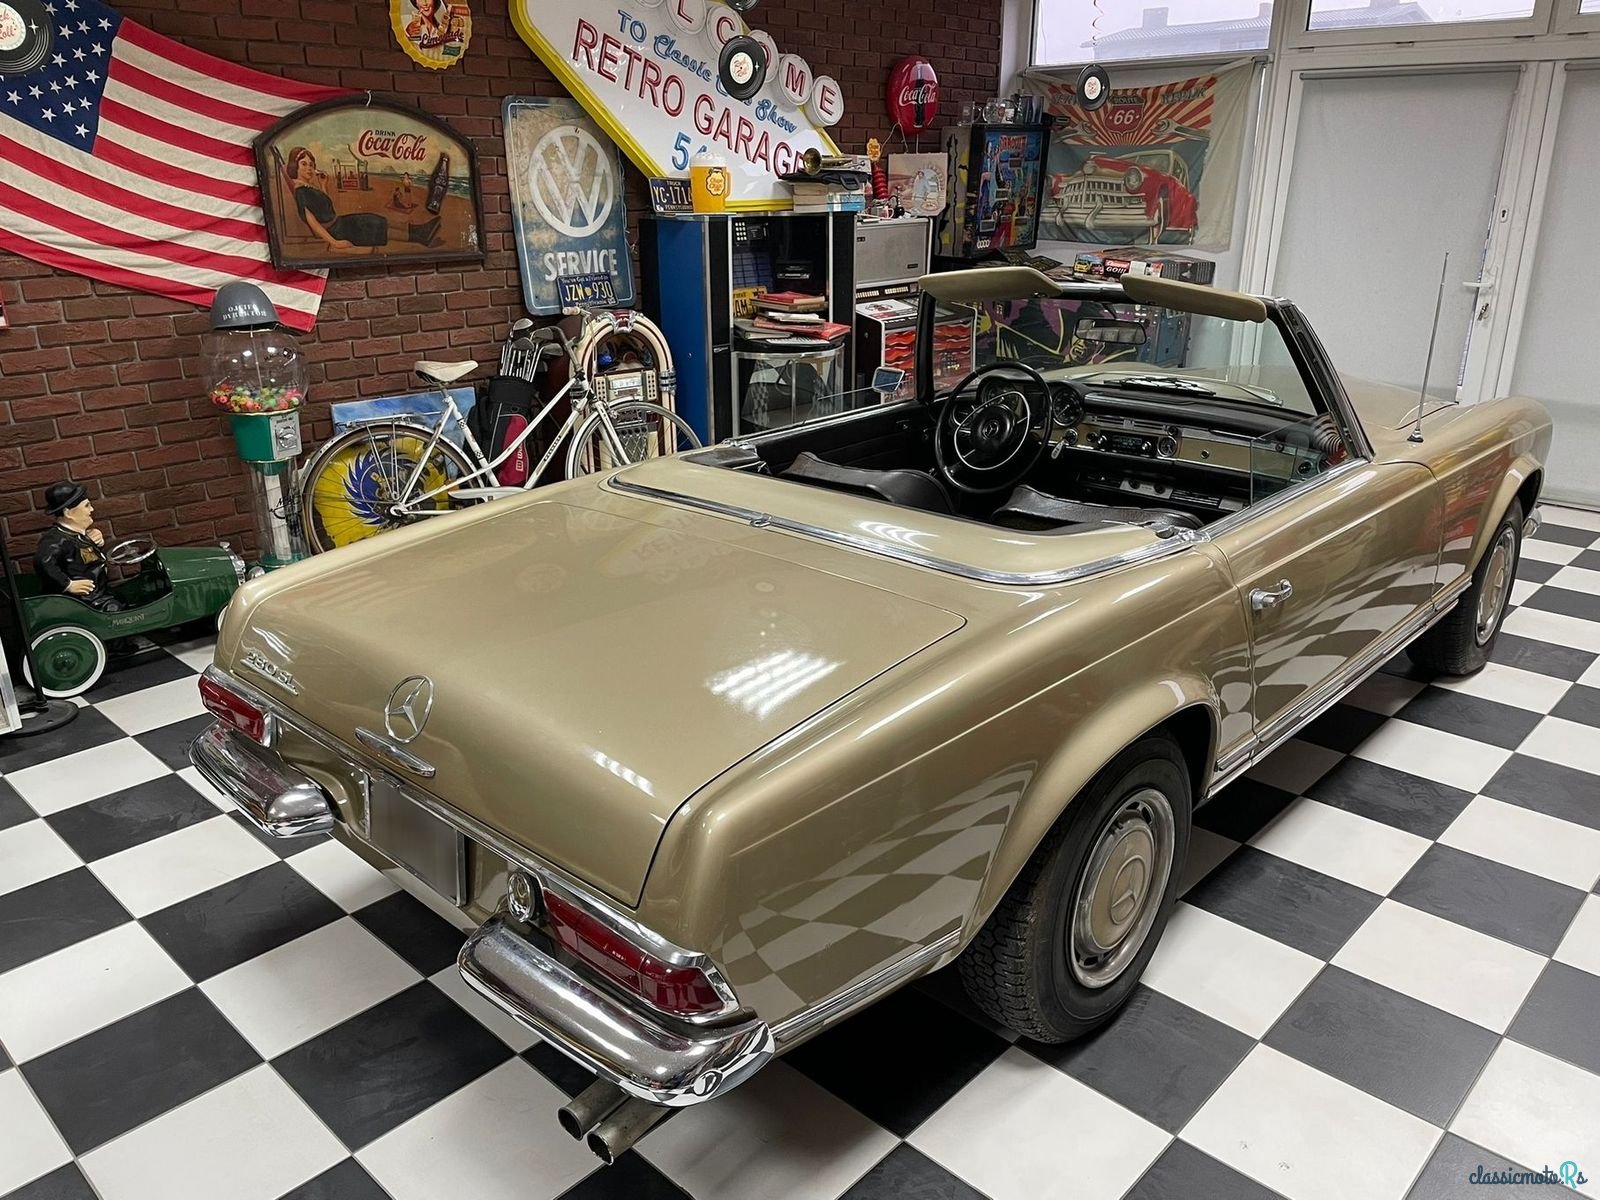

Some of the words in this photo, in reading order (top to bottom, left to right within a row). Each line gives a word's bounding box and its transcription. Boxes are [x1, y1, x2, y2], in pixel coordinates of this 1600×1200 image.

[618, 9, 648, 44] TO
[571, 18, 687, 119] RETRO
[653, 34, 713, 84] Classic
[898, 83, 938, 107] Coca-Cola
[756, 98, 799, 135] Show
[1112, 109, 1135, 126] 66
[358, 130, 428, 161] Coca-Cola
[543, 249, 618, 281] SERVICE
[592, 280, 613, 299] 930
[246, 651, 279, 677] 280
[277, 671, 297, 690] SL
